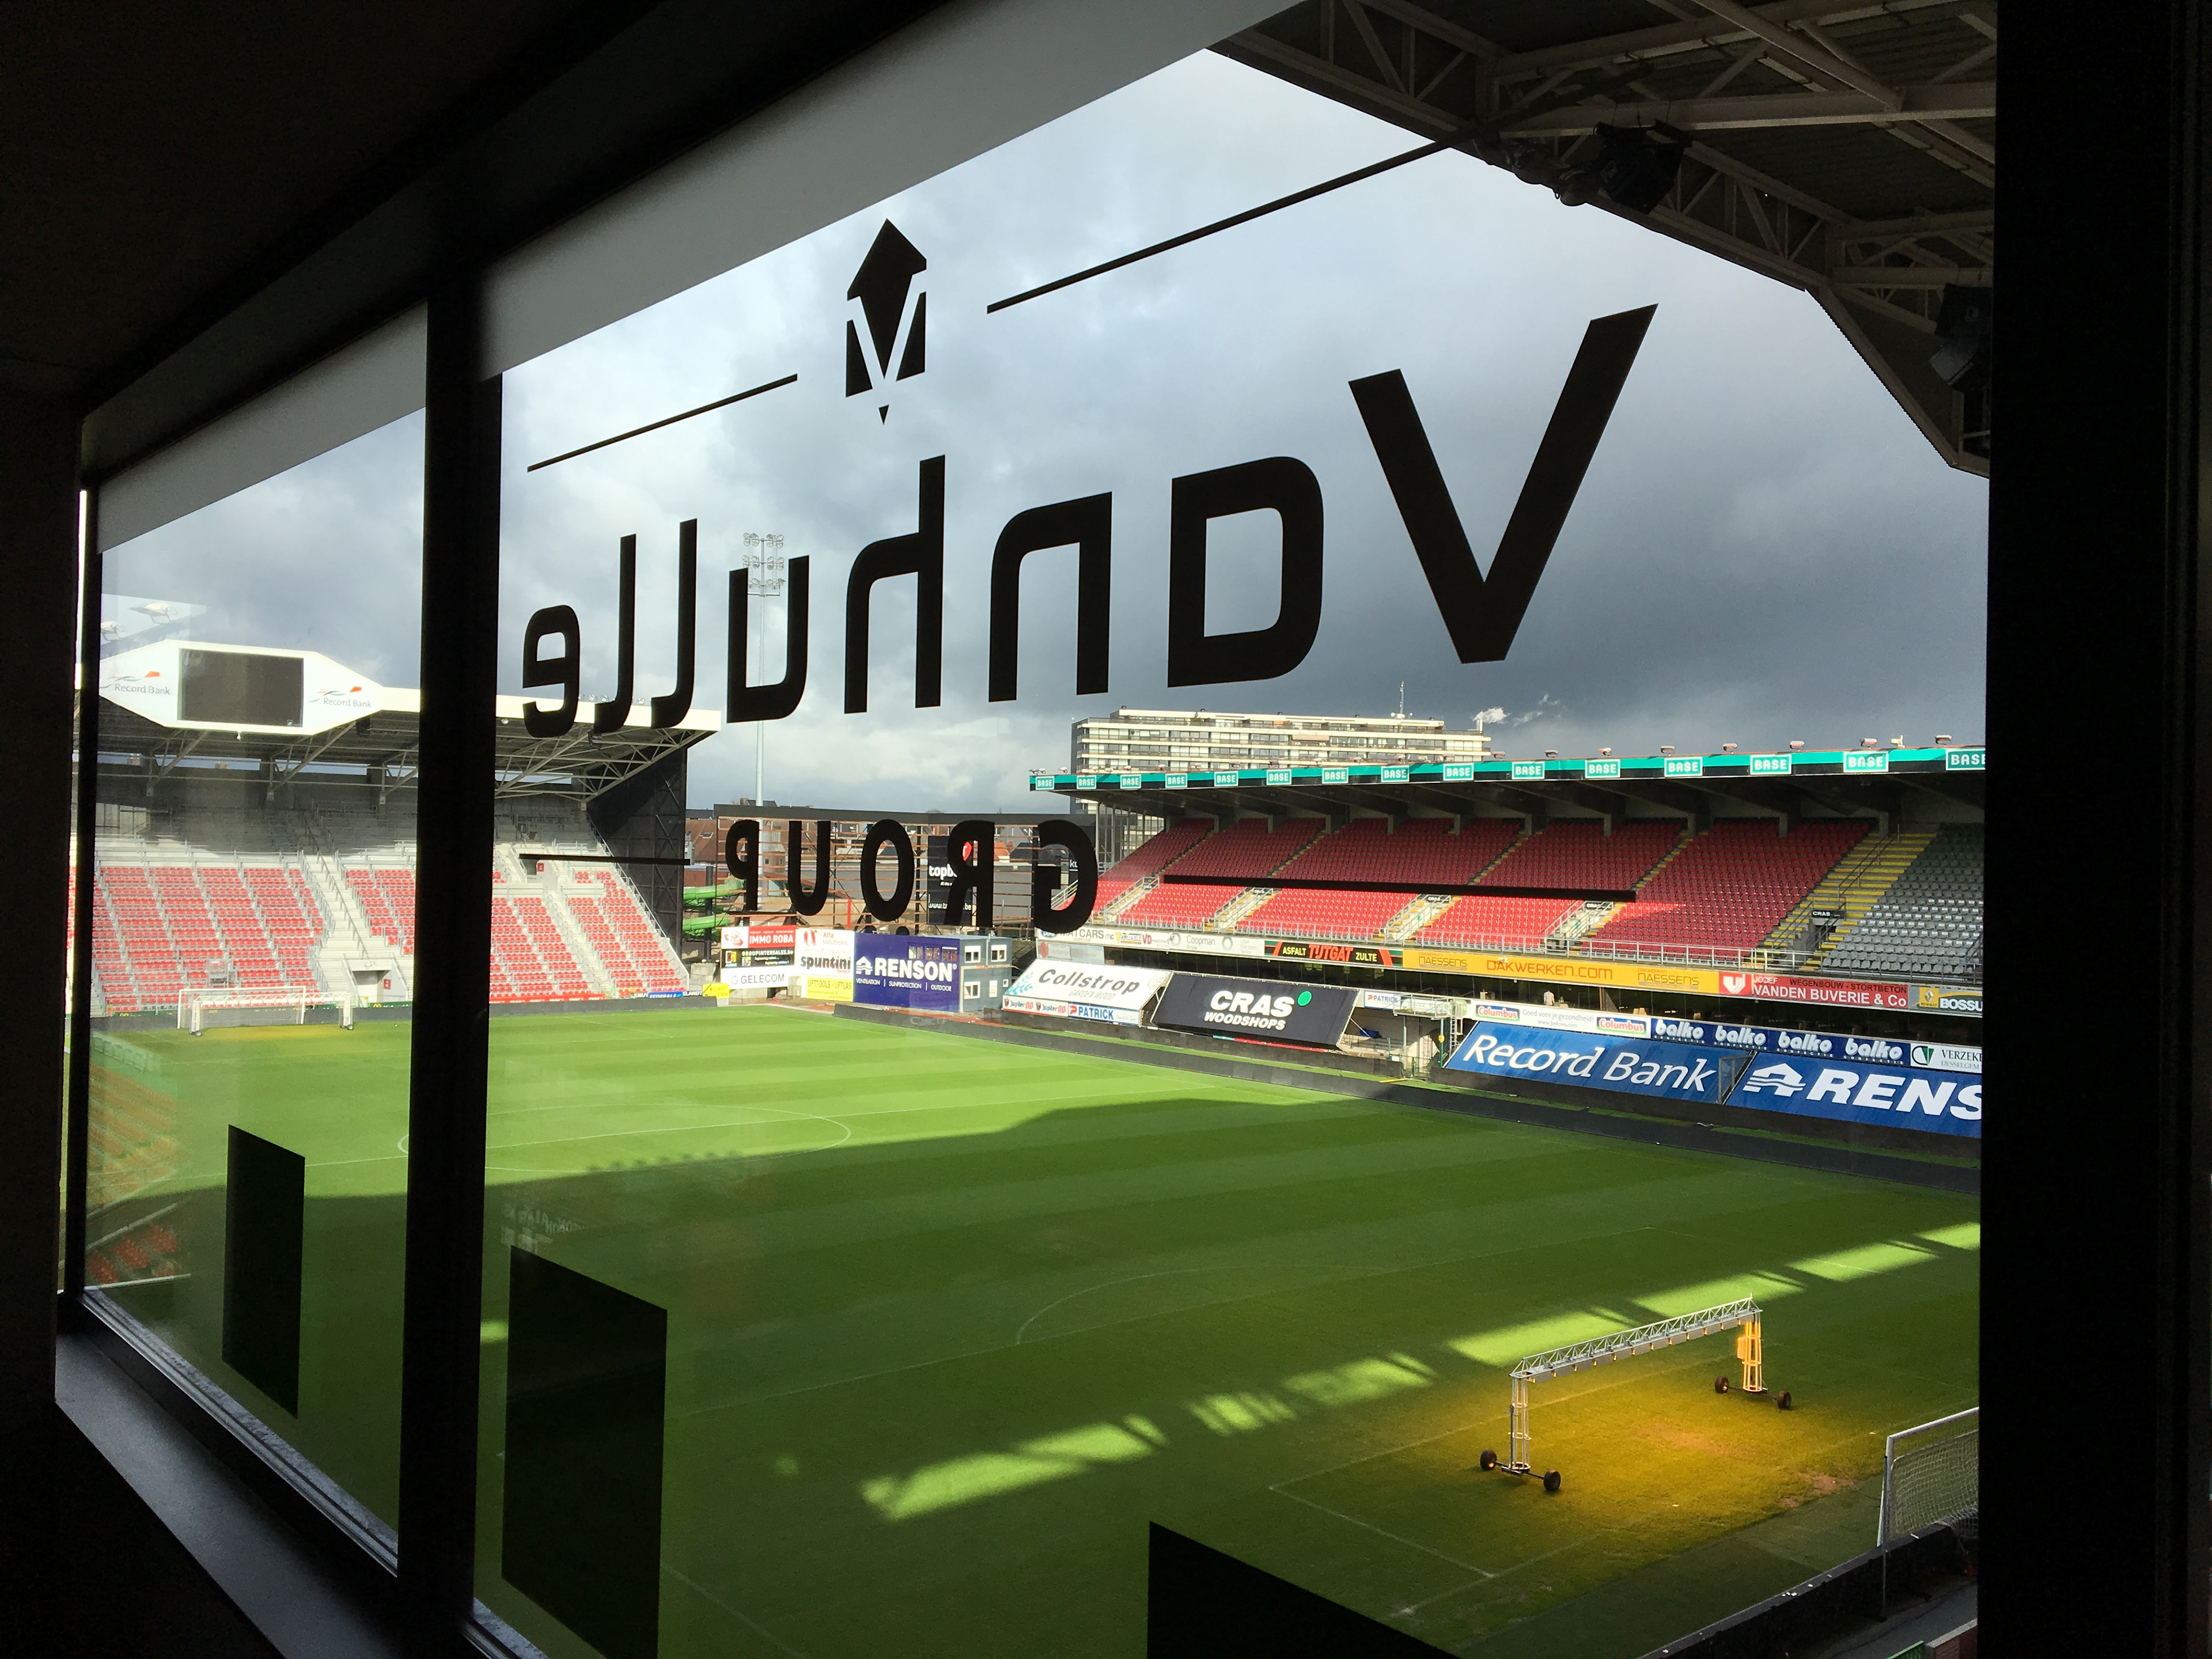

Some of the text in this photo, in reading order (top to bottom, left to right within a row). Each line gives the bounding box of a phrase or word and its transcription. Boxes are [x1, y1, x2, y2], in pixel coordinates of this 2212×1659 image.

[115, 683, 171, 696] Record Bank
[323, 697, 372, 708] Record Bank
[1668, 762, 1698, 772] BASE
[1755, 759, 1787, 770] BASE
[1848, 756, 1883, 768] BASE
[1384, 769, 1406, 779] BASE
[1447, 767, 1471, 777] BASE
[1516, 766, 1541, 775] BASE
[1589, 764, 1616, 774] BASE
[1168, 777, 1185, 785] BASE
[1217, 775, 1236, 783] BASE
[1269, 773, 1289, 781] BASE
[1325, 771, 1346, 781] BASE
[1037, 779, 1052, 787] BASE
[1123, 778, 1139, 786] BASE
[749, 934, 794, 944] IMMO ROBA
[1187, 935, 1215, 946] Coopman
[1282, 946, 1307, 956] ASFALT
[1355, 952, 1377, 962] ZULTE
[800, 956, 851, 970] spuntini
[741, 974, 785, 984] GELECOM
[888, 980, 922, 989] SUNPROTECTION
[1038, 968, 1141, 995] Collstrop
[1753, 976, 1778, 984] JOZEF
[1790, 979, 1844, 989] WEGENBOUW
[1850, 983, 1907, 993] STORTBETON
[1069, 989, 1116, 1001] GARDEN WOOD
[1373, 995, 1398, 1003] PATRICK
[1753, 984, 1907, 1007] VANDEN BUVERIE & Co
[1210, 990, 1295, 1018] CRAS
[1078, 1006, 1114, 1020] PATRICK
[1478, 1005, 1518, 1020] Columbus
[1522, 1009, 1538, 1017] Goed
[1551, 1012, 1558, 1020] je
[1558, 1013, 1594, 1023] gezondheid!
[1204, 1012, 1286, 1031] WOODSHOPS
[1599, 1018, 1643, 1033] Columbus
[1655, 1018, 1704, 1040] balko
[1715, 1025, 1766, 1046] balko
[1778, 1031, 1832, 1053] balko
[1845, 1037, 1903, 1060] balko
[1463, 1035, 1717, 1092] Record Bank
[1941, 1060, 1980, 1070] DESSELGEM
